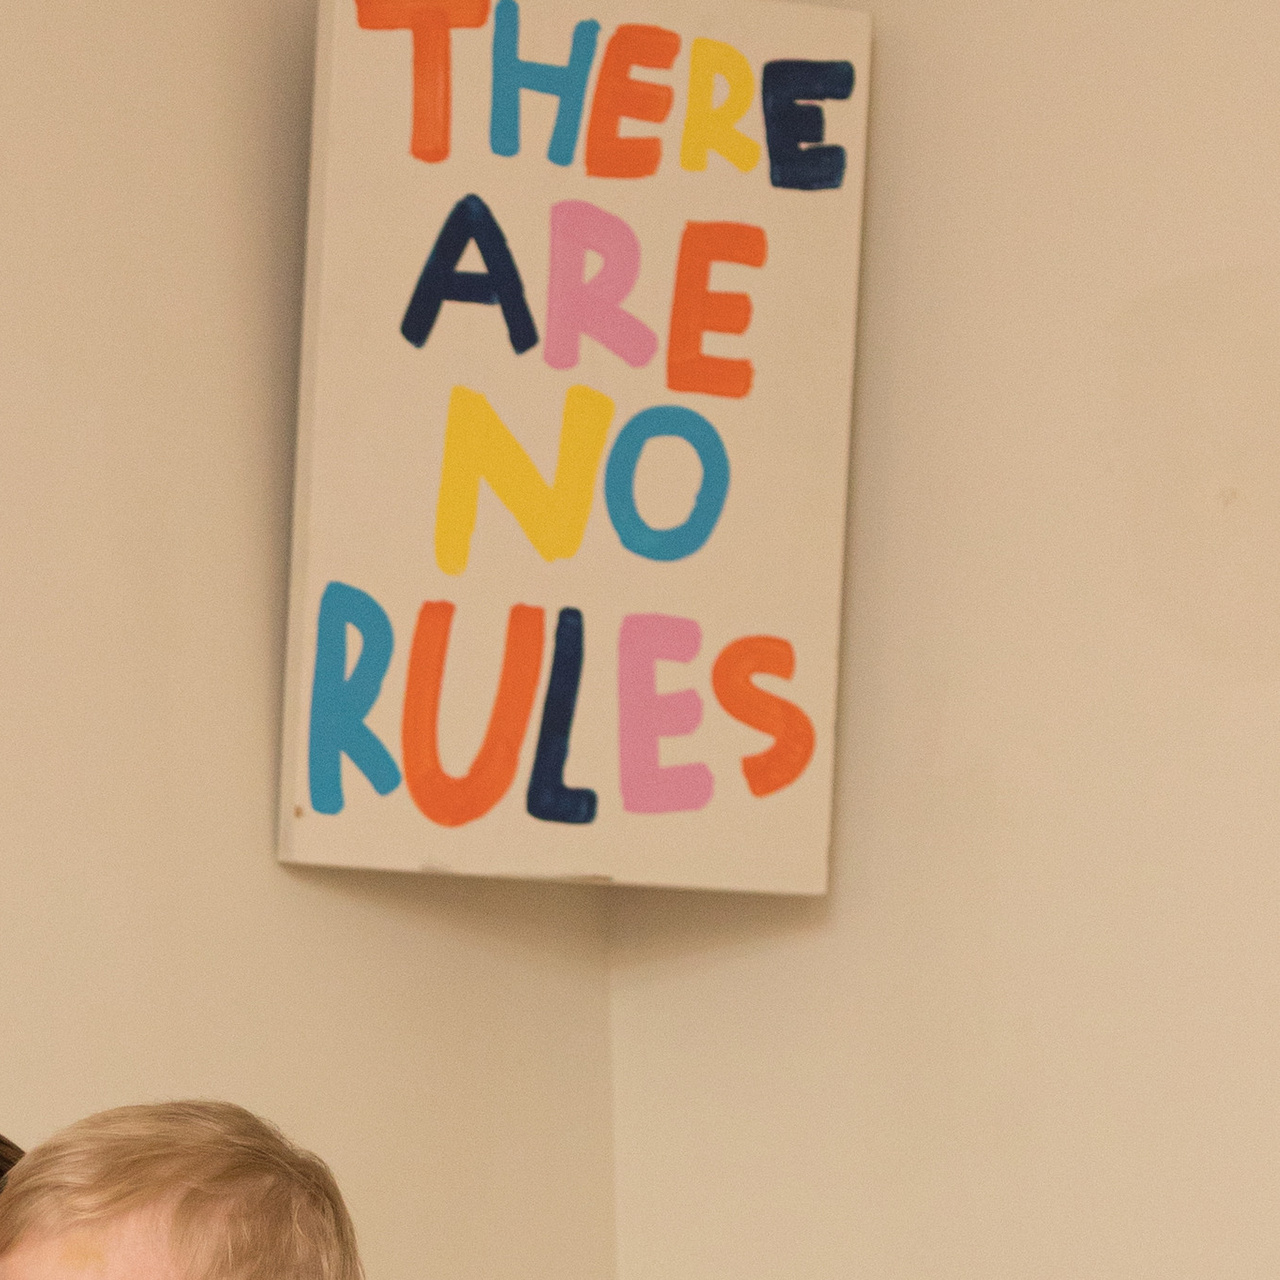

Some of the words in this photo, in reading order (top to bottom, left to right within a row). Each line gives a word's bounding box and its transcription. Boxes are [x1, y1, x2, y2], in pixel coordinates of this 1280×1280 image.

[354, 0, 855, 191] THERE
[400, 193, 768, 399] ARE
[434, 384, 731, 577] NO
[307, 580, 817, 829] RULES
